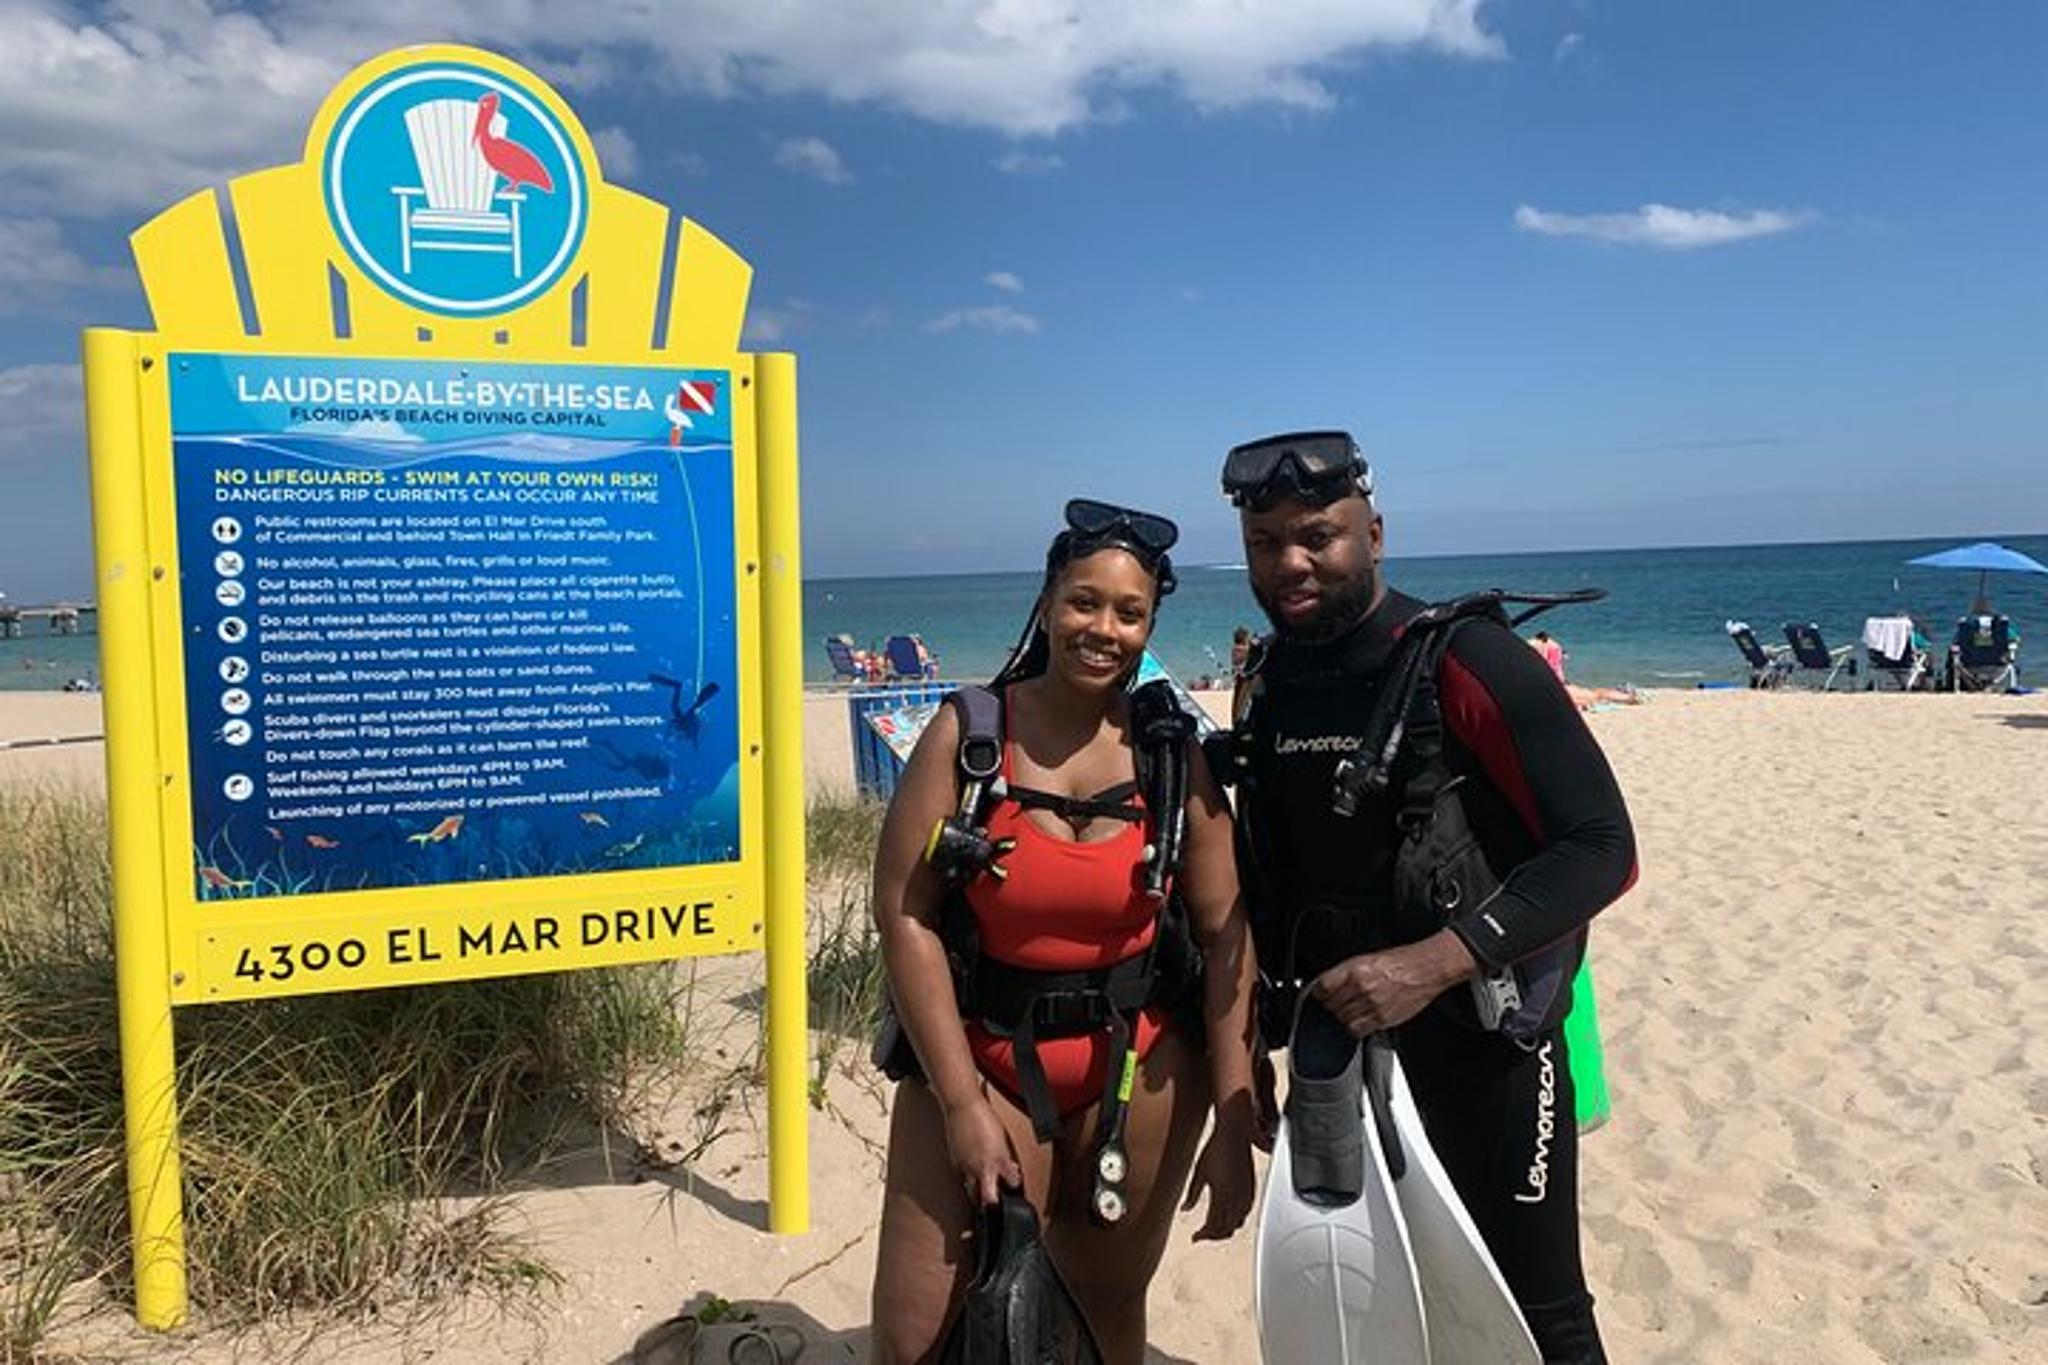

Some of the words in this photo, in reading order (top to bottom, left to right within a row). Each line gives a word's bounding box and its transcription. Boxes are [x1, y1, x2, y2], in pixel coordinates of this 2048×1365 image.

[290, 407, 390, 422] FLORIDA'S
[395, 409, 459, 423] BEACH
[463, 411, 527, 425] DIVING
[531, 412, 605, 427] CAPITAL
[215, 469, 248, 484] NO
[255, 469, 385, 484] LIFEGUARDS
[405, 470, 459, 485] SWIM
[465, 471, 492, 485] AT
[497, 472, 550, 486] YOUR
[557, 473, 604, 486] OWN
[610, 473, 659, 487] RISK!
[215, 488, 334, 502] DANGEROUS
[340, 488, 369, 502] RIP
[374, 488, 470, 503] CURRENTS
[473, 489, 511, 503] CAN
[515, 489, 576, 503] OCCUR
[579, 490, 619, 503] ANY
[622, 490, 659, 504] TIME
[255, 514, 300, 528] Public
[381, 518, 403, 527] are
[406, 515, 459, 527] located
[462, 517, 481, 527] on
[484, 515, 498, 527] El
[501, 515, 527, 527] Mar
[531, 515, 566, 527] Drive
[569, 515, 607, 527] south
[255, 531, 271, 544] of
[275, 531, 362, 543] Commercial
[366, 531, 393, 542] and
[396, 531, 445, 542] behind
[489, 530, 515, 542] Hall
[579, 530, 621, 543] Family
[256, 557, 279, 569] No
[482, 555, 515, 569] grills
[518, 557, 533, 566] or
[537, 554, 567, 566] loud
[258, 578, 285, 590] Our
[289, 578, 334, 590] beach
[352, 578, 378, 589] not
[381, 580, 412, 591] your
[520, 576, 557, 588] place
[579, 574, 638, 588] cigarette
[258, 594, 285, 607] and
[290, 593, 335, 605] debris
[356, 592, 380, 604] the
[384, 592, 418, 603] trash
[423, 592, 449, 602] and
[452, 590, 515, 604] recycling
[518, 591, 549, 601] cans
[568, 590, 591, 600] the
[594, 589, 634, 600] beach
[259, 614, 281, 627] Do
[284, 615, 309, 626] not
[313, 614, 364, 626] release
[451, 611, 480, 624] they
[485, 612, 509, 621] can
[512, 610, 547, 621] harm
[416, 628, 439, 638] sea
[443, 626, 487, 637] turtles
[491, 625, 518, 636] and
[521, 624, 556, 635] other
[559, 624, 606, 635] marine
[261, 651, 336, 663] Disturbing
[353, 651, 378, 660] sea
[381, 648, 419, 660] turtle
[423, 648, 452, 659] nest
[546, 644, 560, 655] of
[261, 673, 284, 684] Do
[287, 672, 312, 684] not
[315, 671, 348, 683] walk
[352, 669, 409, 682] through
[412, 668, 435, 679] the
[439, 669, 461, 679] sea
[466, 667, 495, 677] oats
[517, 664, 550, 676] sand
[264, 693, 284, 705] All
[287, 692, 360, 705] swimmers
[363, 690, 398, 702] must
[402, 690, 430, 703] stay
[434, 687, 463, 700] 300
[466, 686, 493, 698] feet
[497, 686, 532, 698] away
[535, 684, 568, 695] from
[264, 714, 309, 726] Scuba
[313, 712, 356, 725] divers
[359, 711, 388, 722] and
[502, 704, 549, 717] display
[554, 702, 609, 714] Florida's
[264, 728, 356, 742] Divers-down
[359, 726, 390, 738] Flag
[394, 724, 446, 737] beyond
[450, 723, 472, 734] the
[266, 751, 288, 763] Do
[290, 750, 315, 761] not
[318, 748, 360, 760] touch
[363, 748, 389, 759] any
[469, 742, 495, 753] can
[497, 741, 532, 751] harm
[534, 738, 557, 749] the
[267, 771, 297, 783] Surf
[301, 769, 348, 782] fishing
[515, 761, 529, 771] to
[267, 784, 342, 797] Weekends
[346, 782, 373, 795] and
[375, 780, 434, 793] holidays
[269, 806, 343, 819] Launching
[347, 803, 362, 815] of
[364, 803, 390, 815] any
[550, 789, 590, 802] vessel
[235, 938, 366, 983] 4300
[388, 927, 441, 964] EL
[458, 917, 560, 957] MAR
[581, 903, 715, 946] DRIVE
